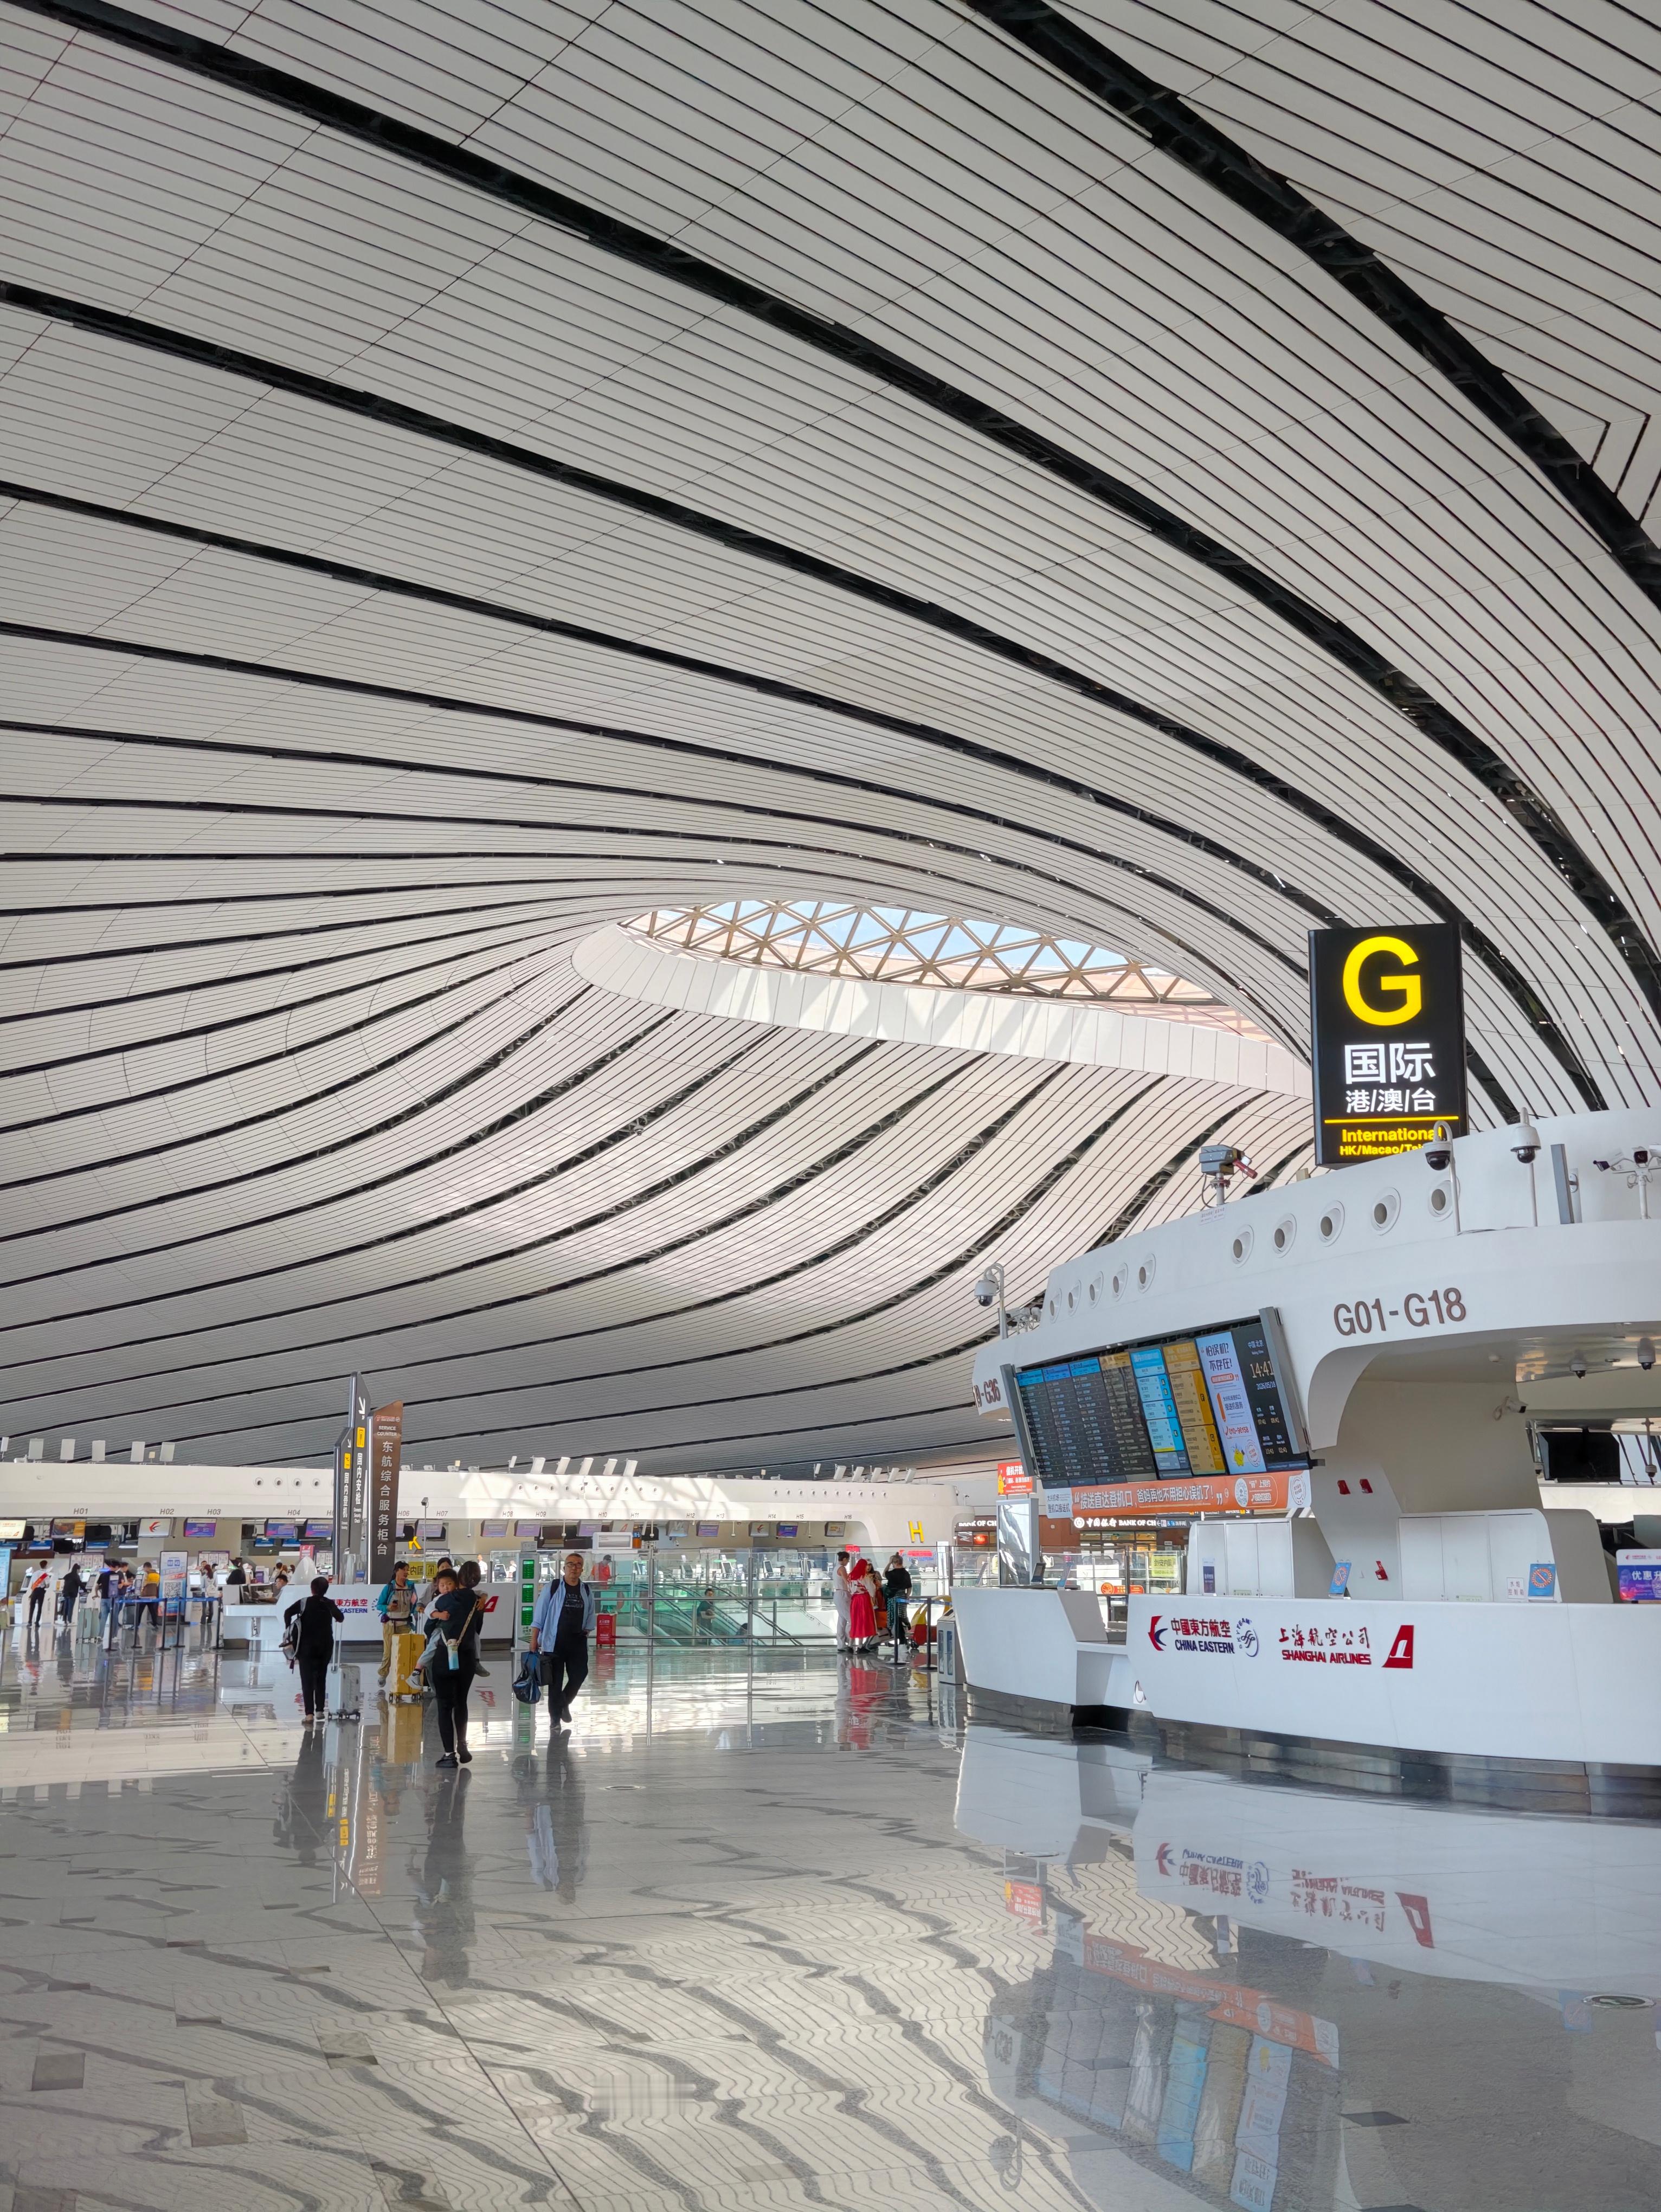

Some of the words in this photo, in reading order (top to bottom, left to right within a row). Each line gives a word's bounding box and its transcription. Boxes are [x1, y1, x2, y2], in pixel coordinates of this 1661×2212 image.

[1343, 936, 1422, 1026] G
[1344, 1043, 1437, 1084] 国际
[1345, 1088, 1437, 1113] 港/澳/台
[1334, 1287, 1466, 1336] G01-G18
[1250, 1361, 1273, 1378] 14:41
[355, 1452, 363, 1505] 国内安检
[377, 1441, 395, 1555] 东航综合服务柜台
[909, 1521, 925, 1543] H
[1086, 1518, 1117, 1528] 中国银行
[1171, 1618, 1232, 1638] 中國東方航空
[1279, 1624, 1370, 1649] 上海航空公司
[1175, 1639, 1198, 1651] CHINA
[1199, 1641, 1235, 1654] EASTERN
[1282, 1649, 1327, 1663] SHANGHAI
[1329, 1652, 1372, 1666] AIRLINES
